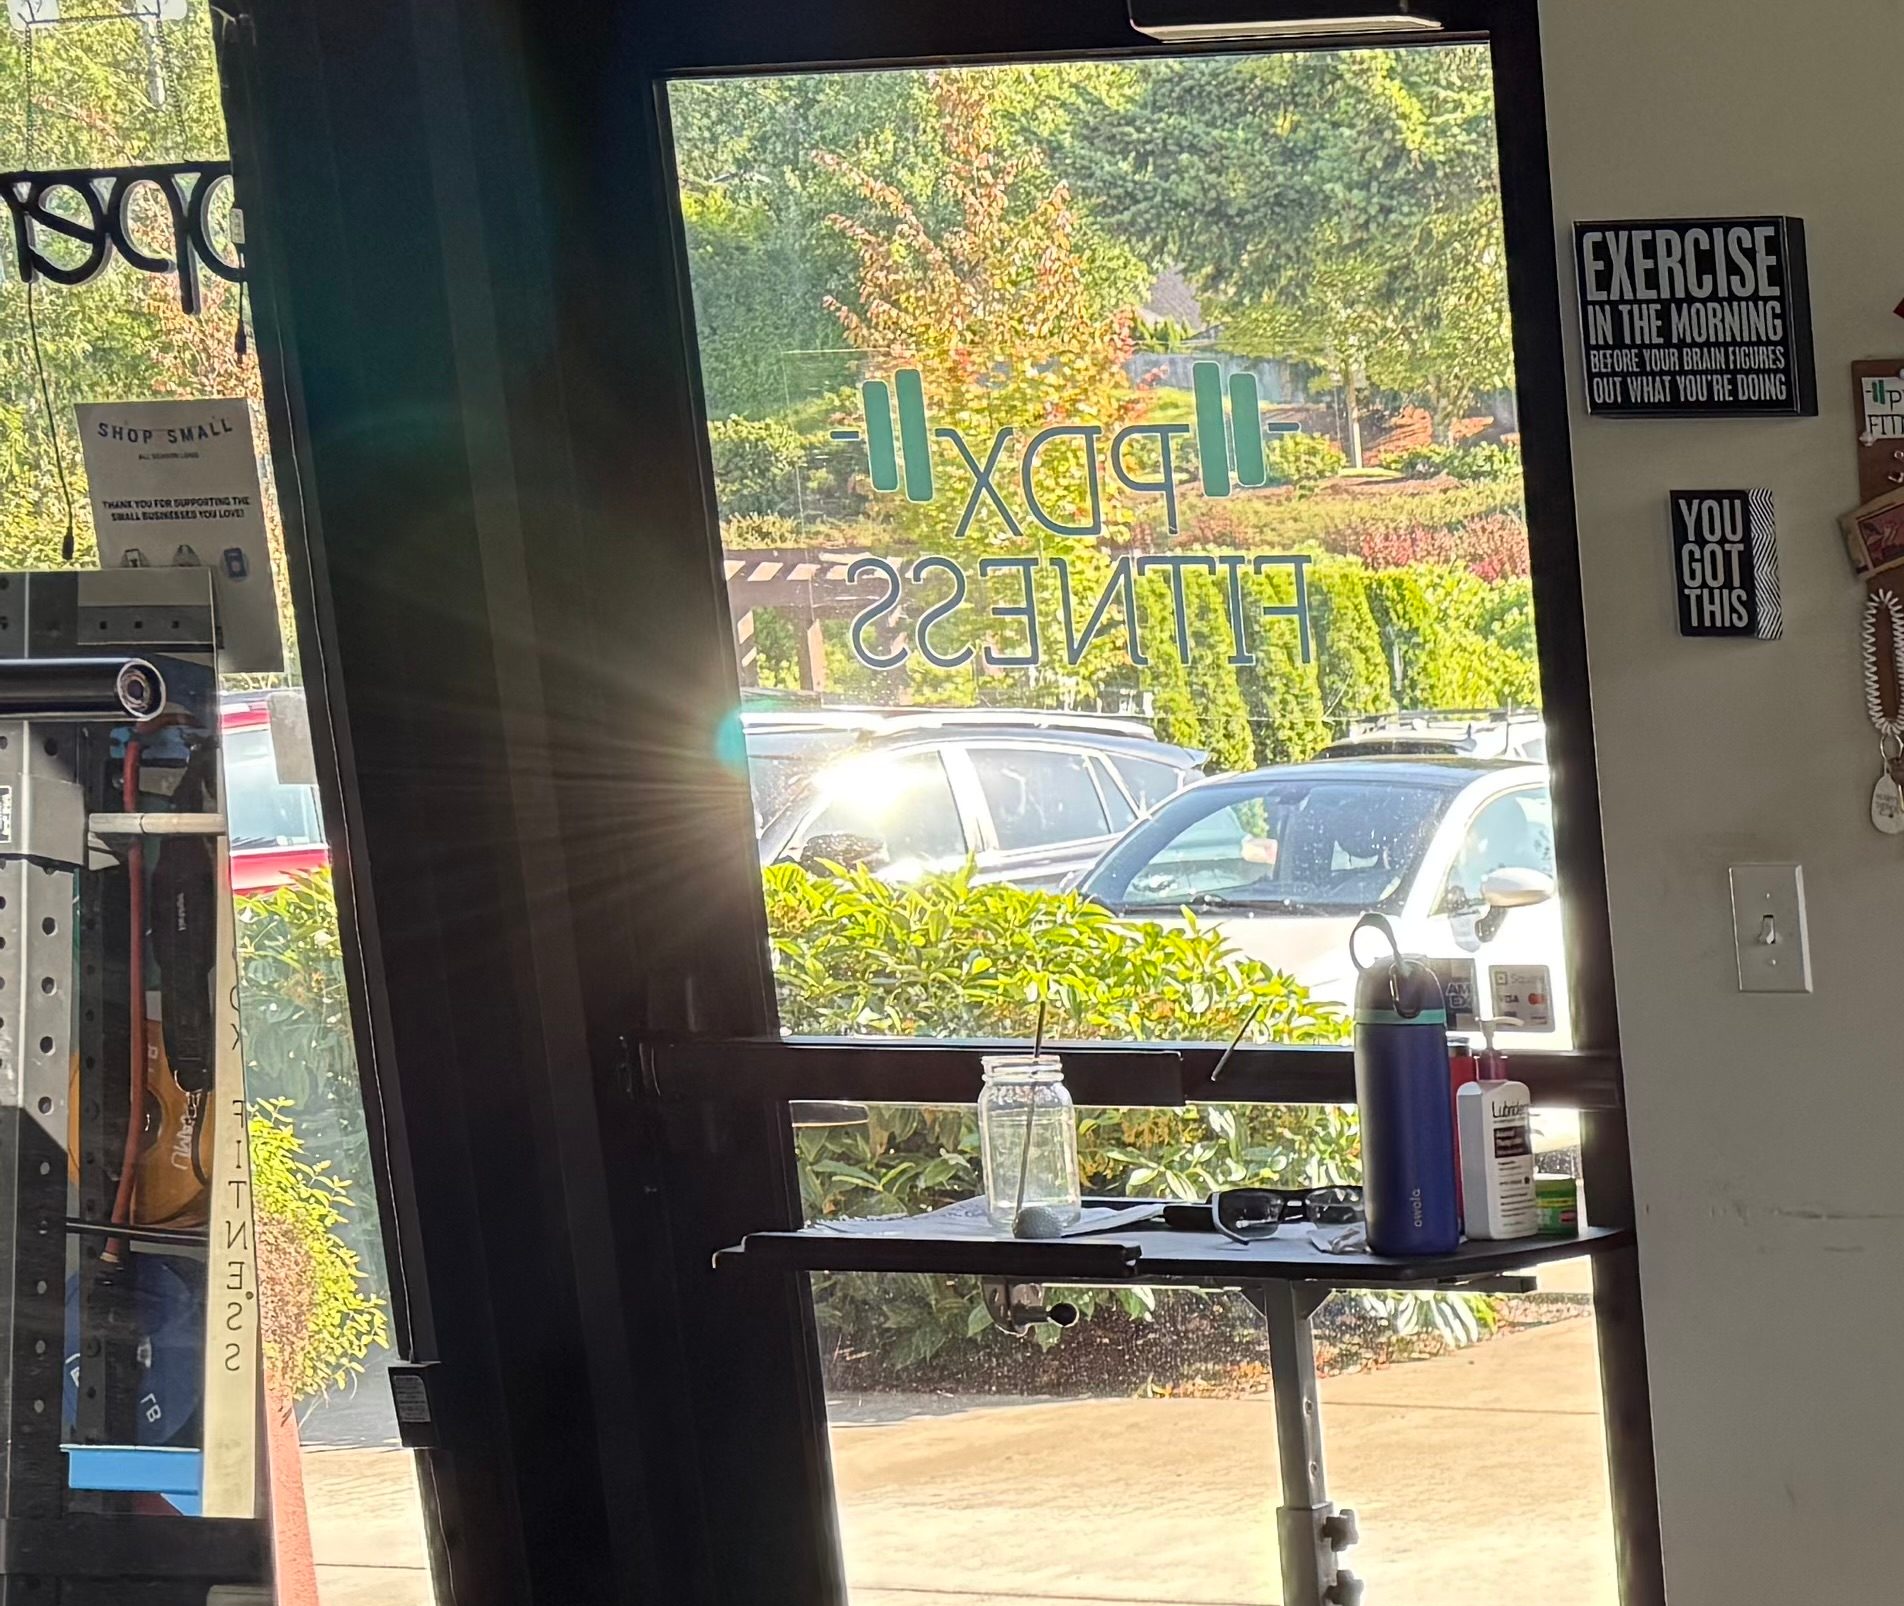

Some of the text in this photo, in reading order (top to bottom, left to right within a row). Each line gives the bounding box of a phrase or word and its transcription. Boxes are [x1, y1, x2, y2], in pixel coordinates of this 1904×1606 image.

[1583, 226, 1780, 301] EXERCISE
[1587, 300, 1784, 345] IN THE MORNING
[1590, 346, 1785, 373] BEFORE YOUR BRAIN FIGURES
[1593, 373, 1787, 404] OUT WHAT YOU'RE DOING
[98, 418, 233, 443] SHOP SMALL
[103, 496, 251, 509] THANK YOU FOR SUPPORTING THE
[111, 511, 141, 521] SMALL
[142, 510, 198, 520] BUSINESSES
[199, 510, 217, 519] YOU
[1678, 499, 1743, 542] YOU
[1681, 542, 1744, 588] GOT
[1684, 588, 1749, 628] THIS
[1409, 1188, 1423, 1227] owala
